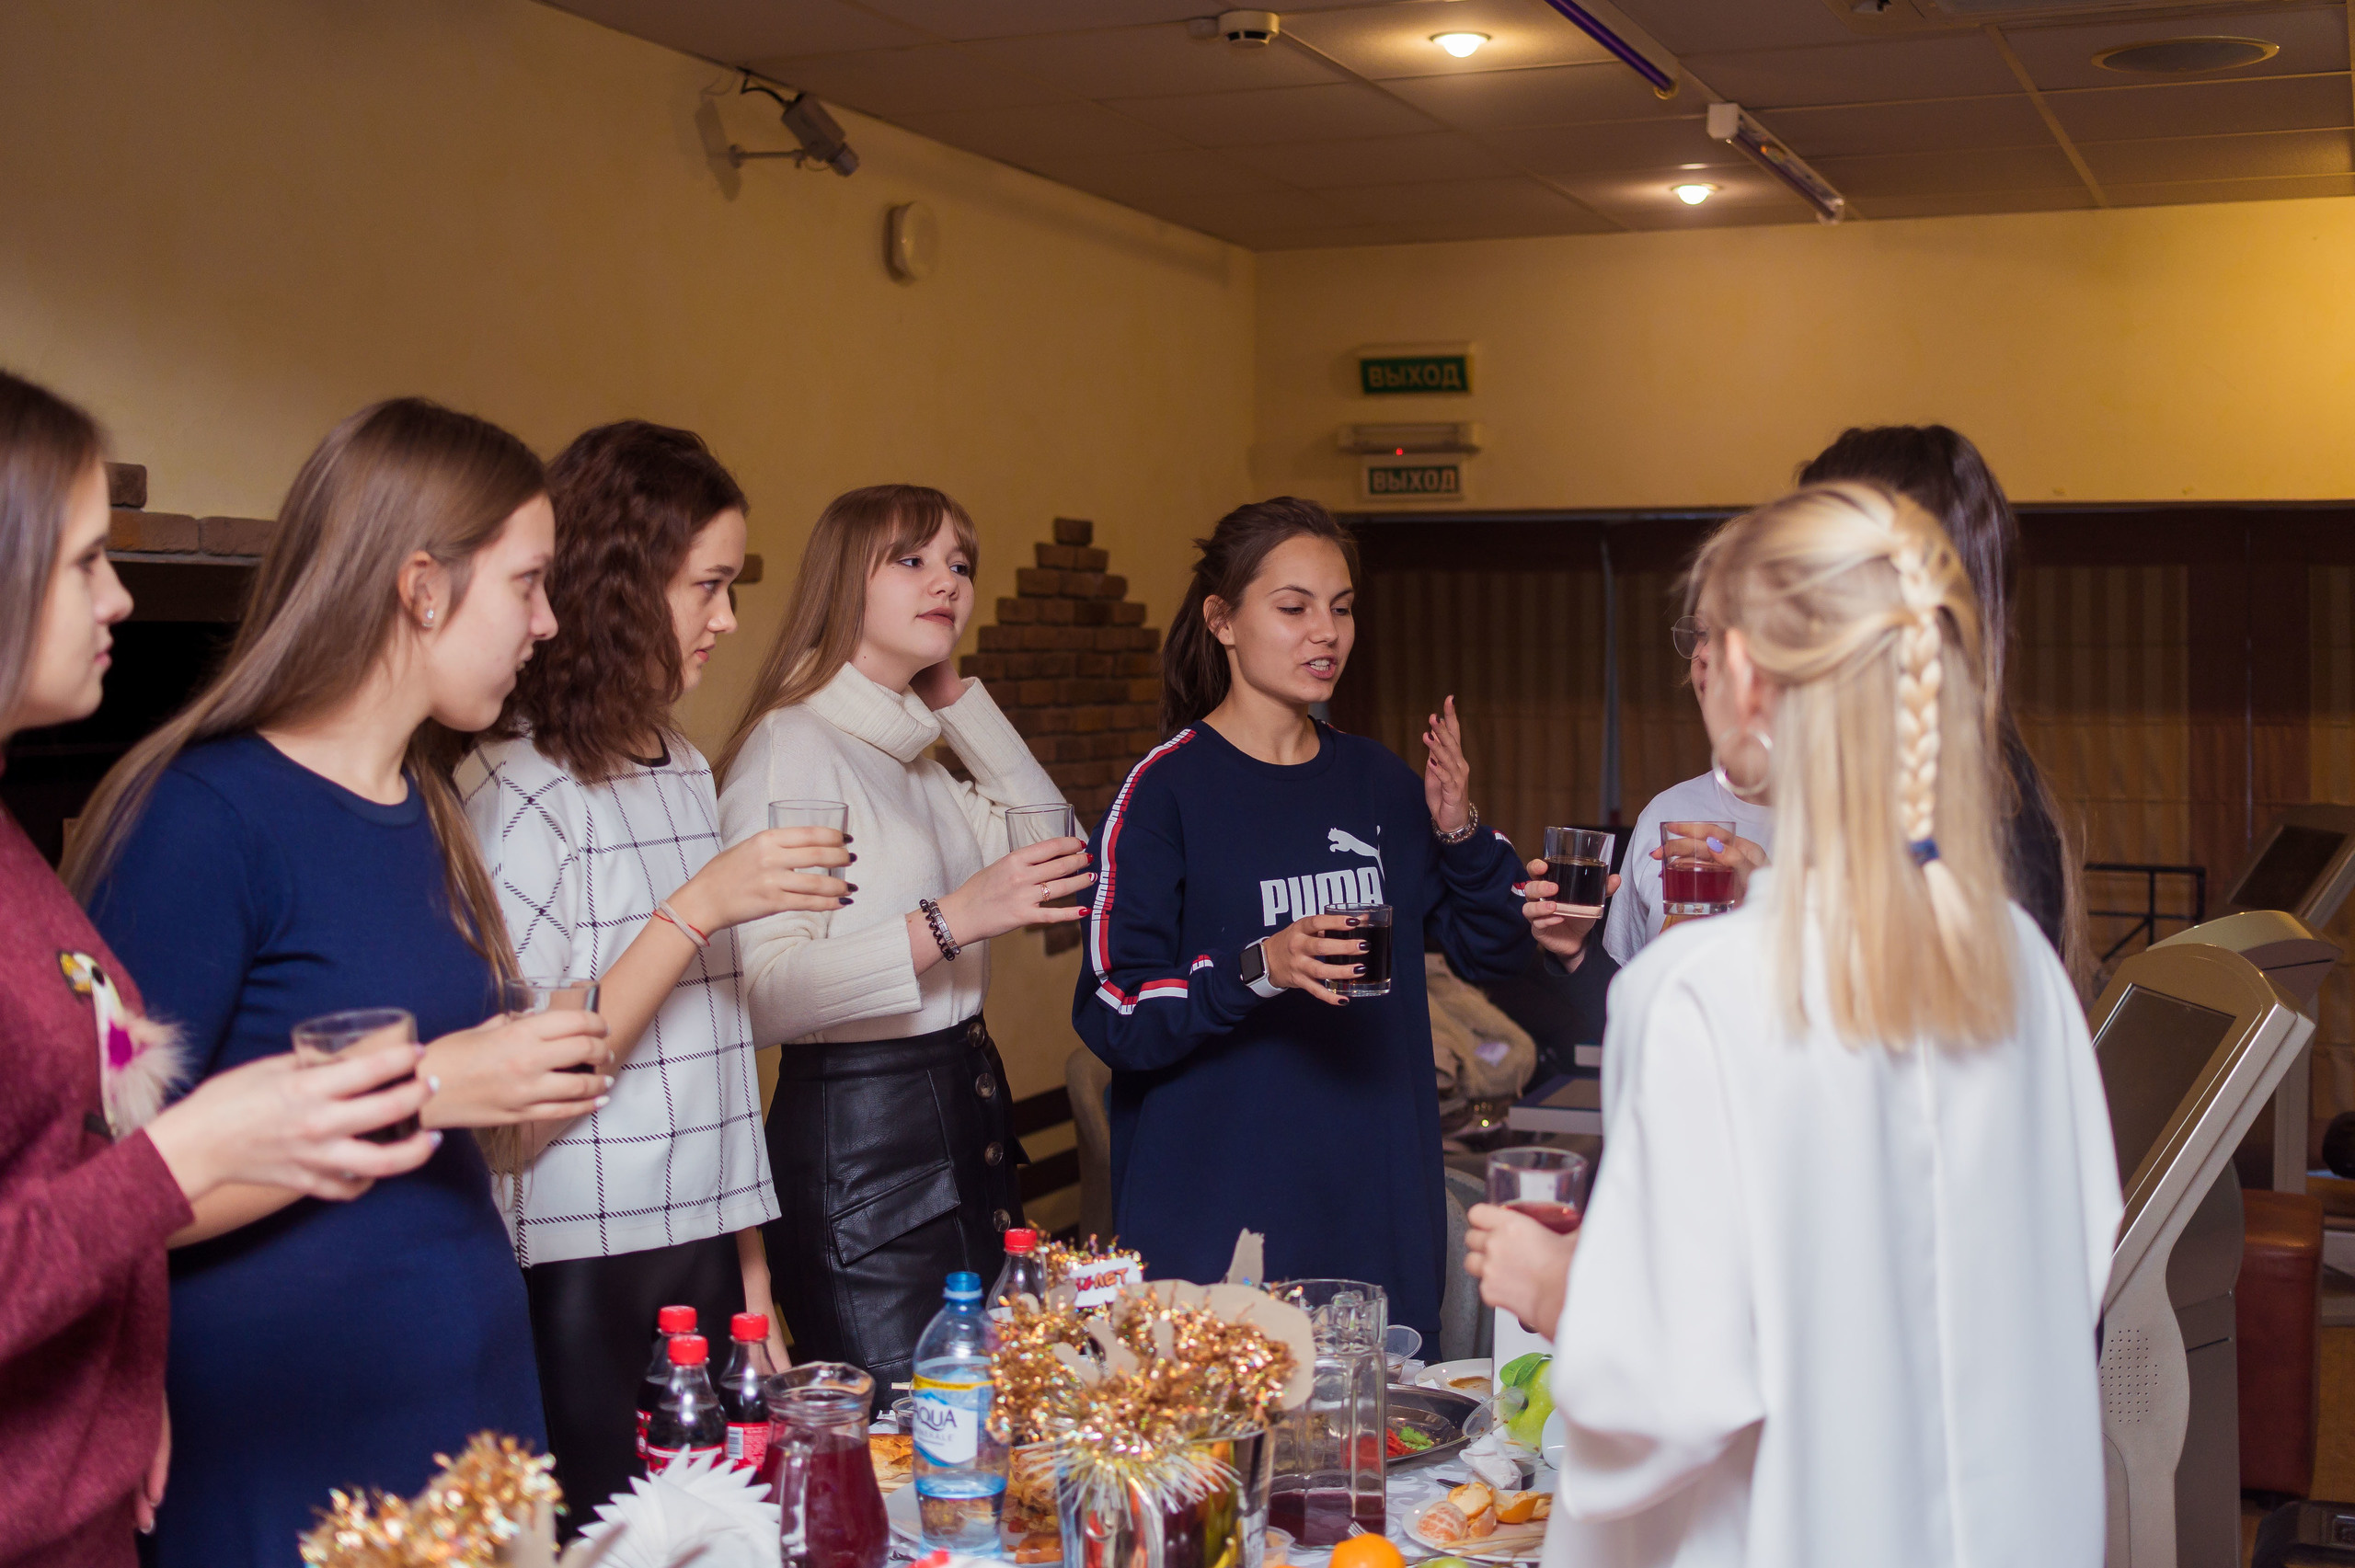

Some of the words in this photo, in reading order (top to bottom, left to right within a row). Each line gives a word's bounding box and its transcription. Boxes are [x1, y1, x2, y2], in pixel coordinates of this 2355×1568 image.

[1367, 363, 1462, 389] ВЫХОД
[1372, 469, 1456, 492] ВЫХОД
[1259, 866, 1384, 927] PUMA
